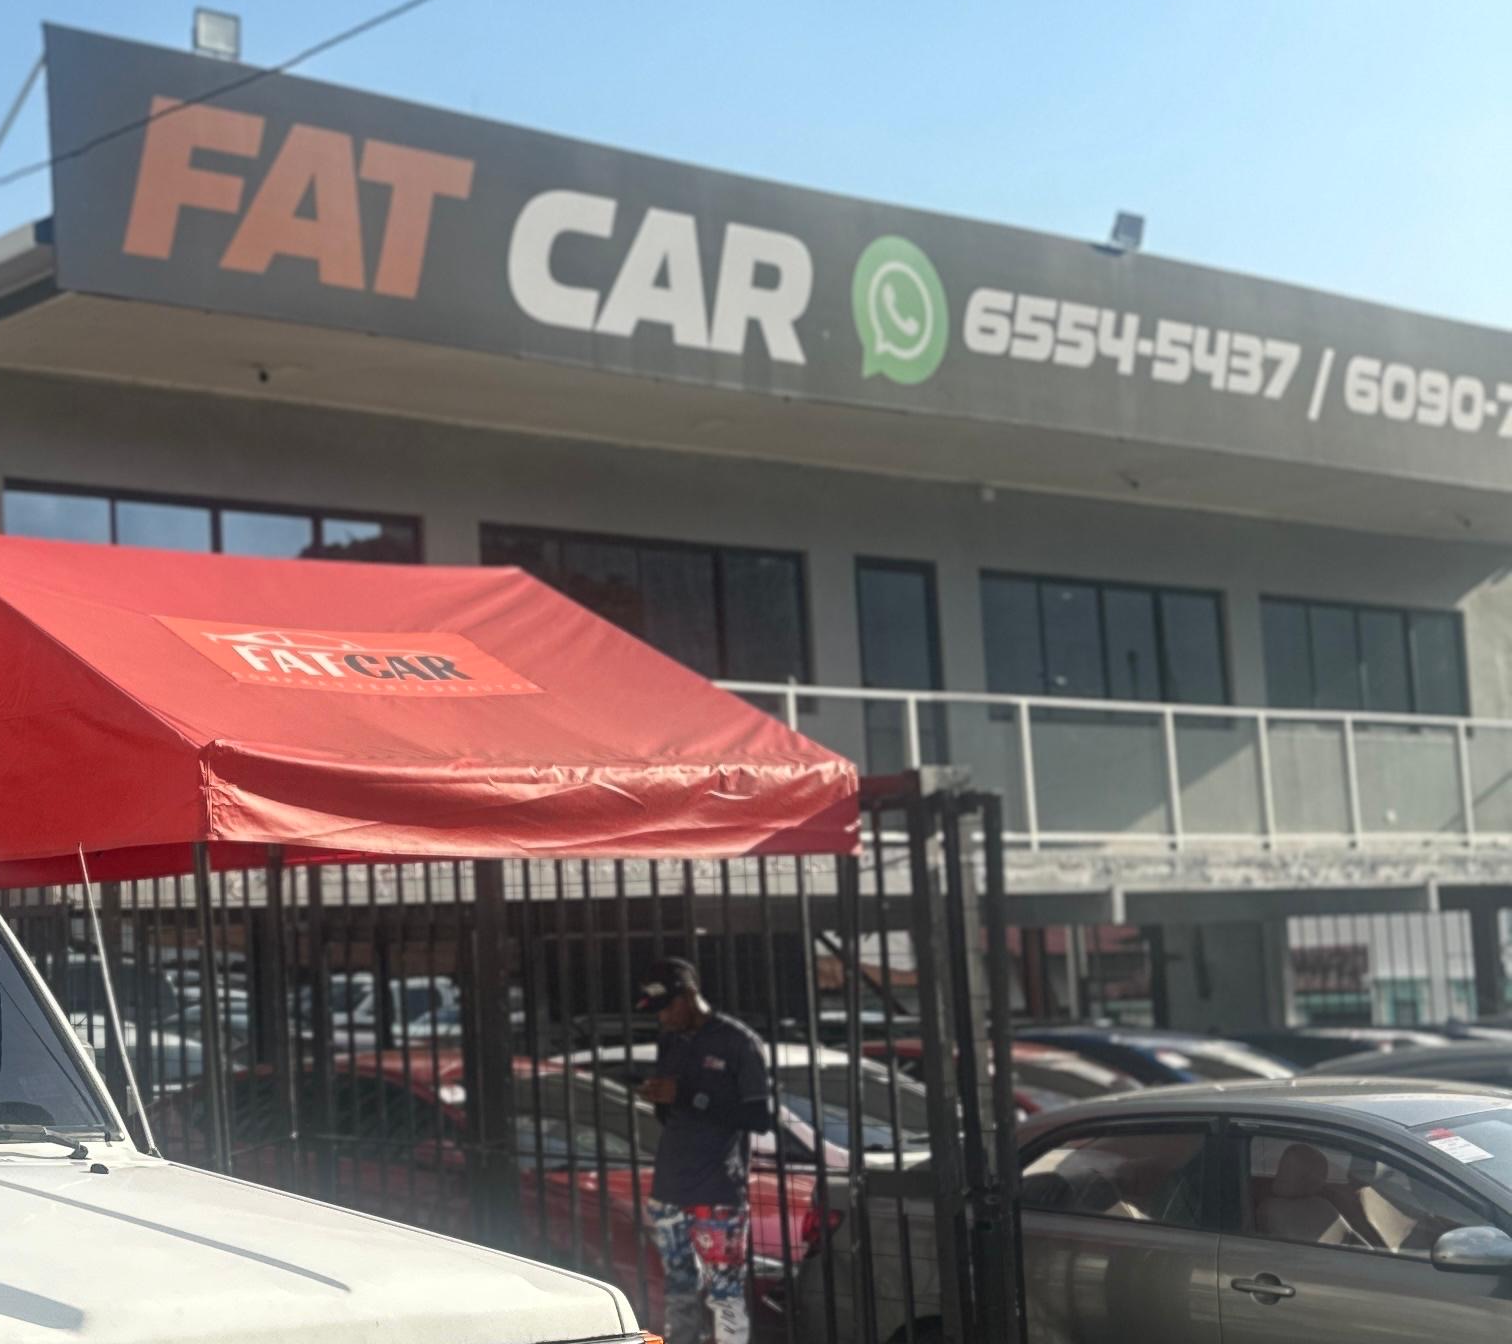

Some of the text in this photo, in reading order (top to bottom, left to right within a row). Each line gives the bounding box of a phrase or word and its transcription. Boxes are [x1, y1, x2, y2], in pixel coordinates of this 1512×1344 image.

[123, 95, 814, 365] FAT CAR
[963, 287, 1301, 399] 6554-5437
